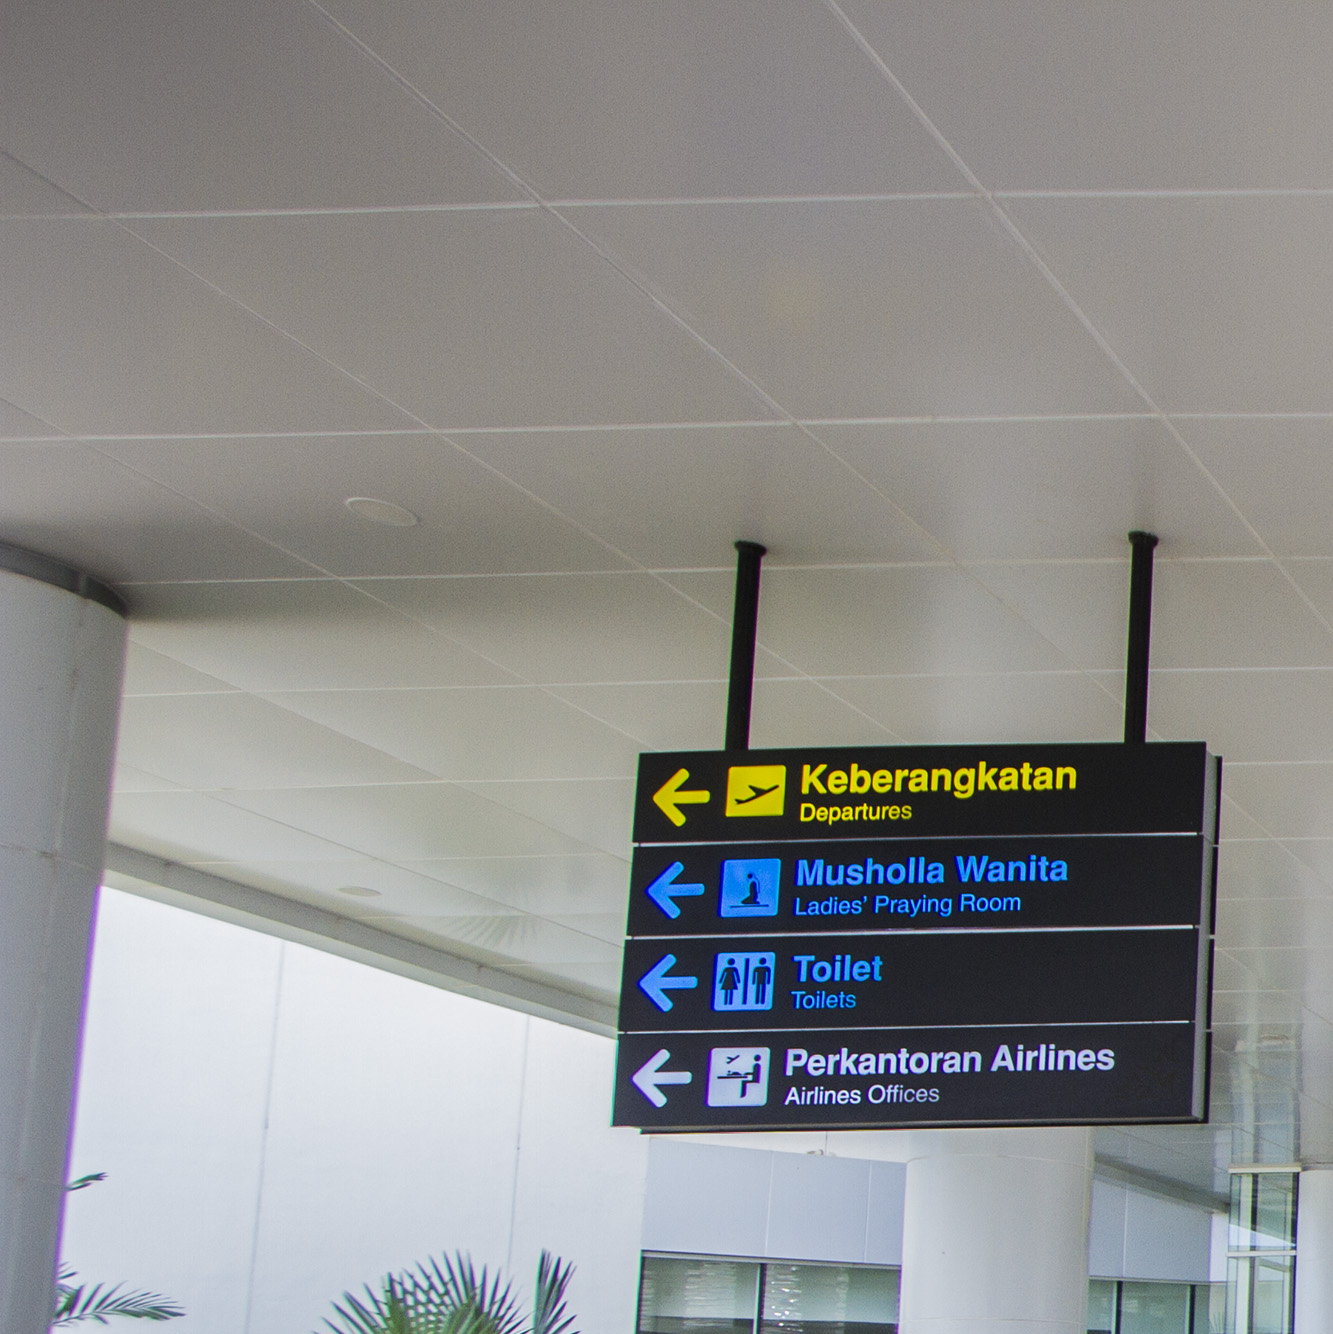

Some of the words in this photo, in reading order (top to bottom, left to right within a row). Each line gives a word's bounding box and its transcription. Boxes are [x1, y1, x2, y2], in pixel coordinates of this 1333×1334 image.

[800, 761, 1077, 799] Keberangkatan
[799, 802, 913, 826] Departures
[794, 857, 945, 886] Musholla
[955, 854, 1068, 883] Wanita
[793, 895, 868, 917] Ladies'
[874, 894, 953, 918] Praying
[959, 893, 1022, 913] Room
[791, 954, 883, 983] Toilet
[790, 991, 857, 1010] Toilets
[784, 1047, 983, 1076] Perkantoran
[989, 1043, 1116, 1073] Airlines
[784, 1087, 862, 1106] Airlines
[867, 1084, 940, 1104] Offices
